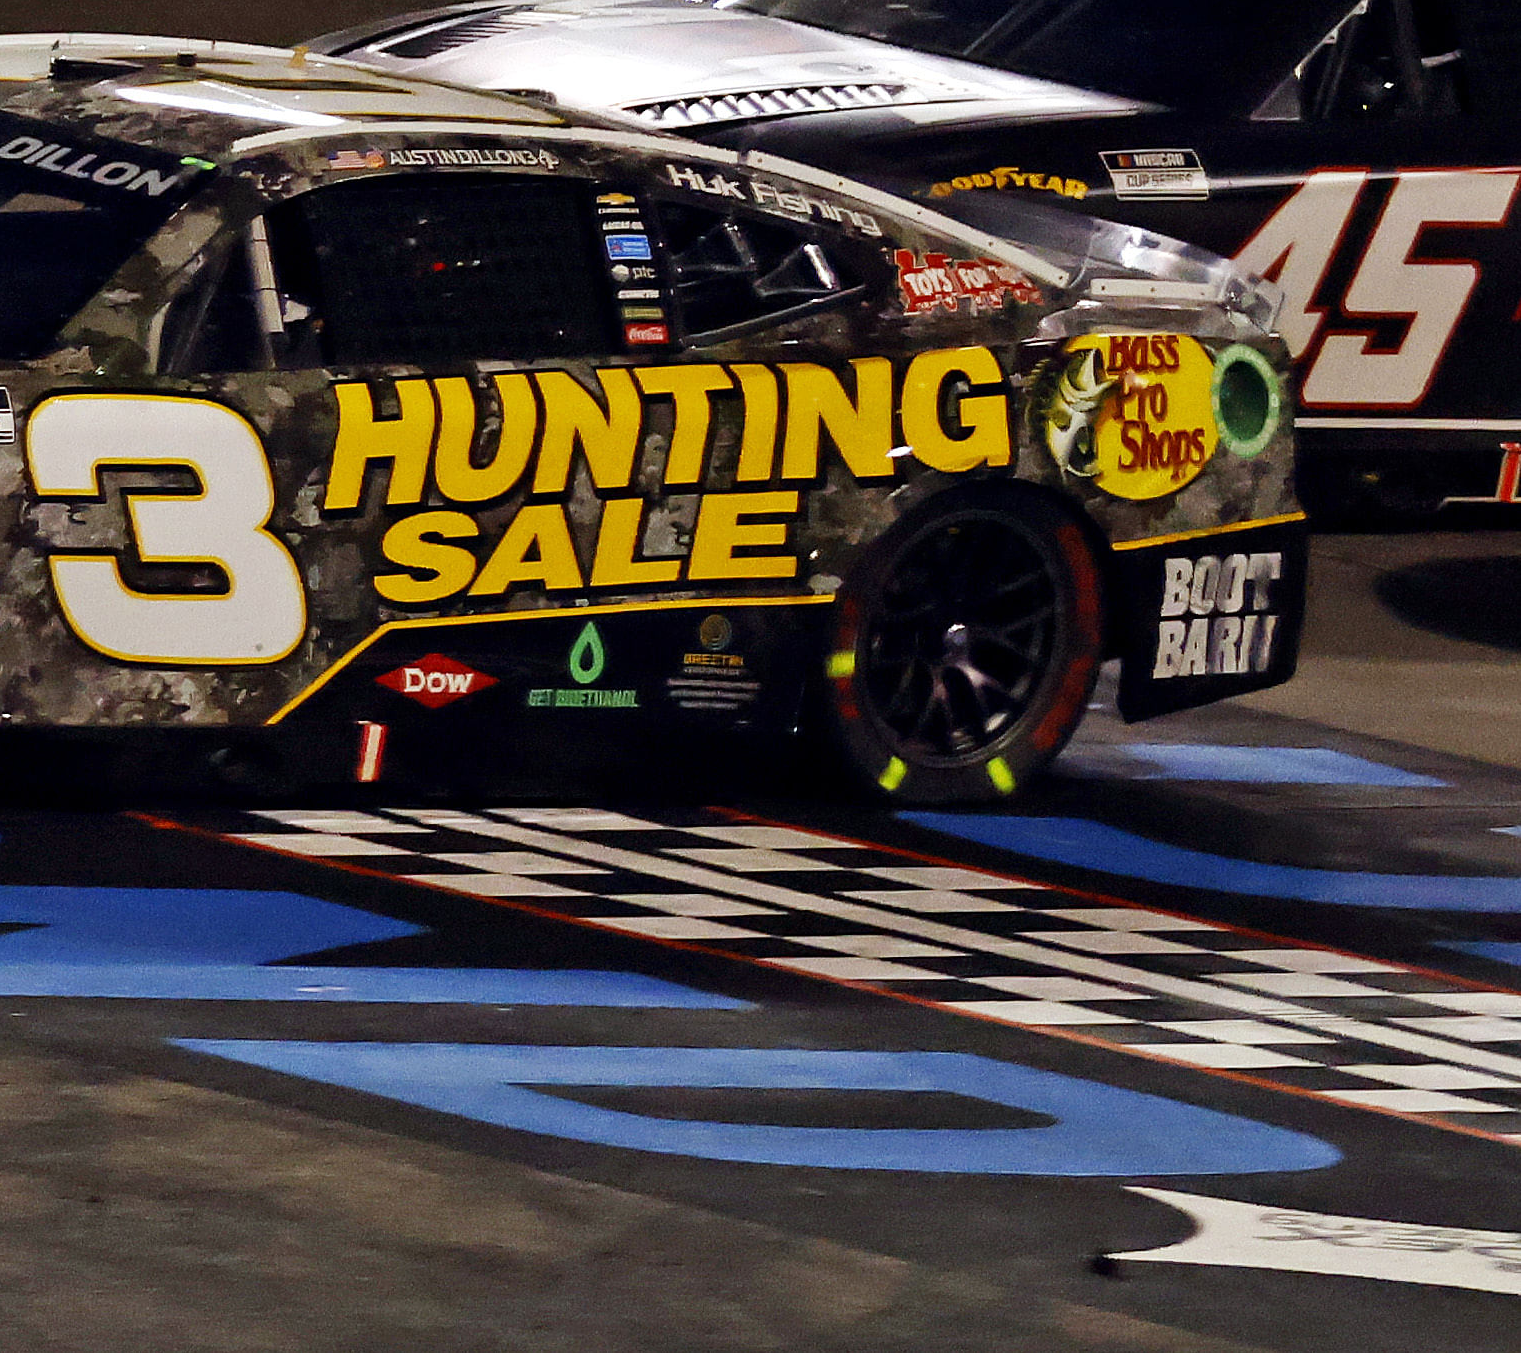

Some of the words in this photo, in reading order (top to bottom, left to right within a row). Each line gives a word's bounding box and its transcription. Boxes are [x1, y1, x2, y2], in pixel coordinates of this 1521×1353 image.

[665, 164, 746, 200] Huk
[749, 181, 883, 237] Fishing
[903, 267, 954, 296] TOYS
[957, 267, 993, 289] FOR
[1230, 167, 1521, 409] 45
[1107, 334, 1180, 375] Bass
[323, 345, 1011, 511] HUNTING
[1112, 382, 1168, 423] Pro
[1117, 419, 1206, 482] Shops
[27, 393, 307, 665] 3
[373, 489, 800, 607] SALE
[1160, 551, 1283, 617] BOOT
[403, 667, 475, 694] Dow
